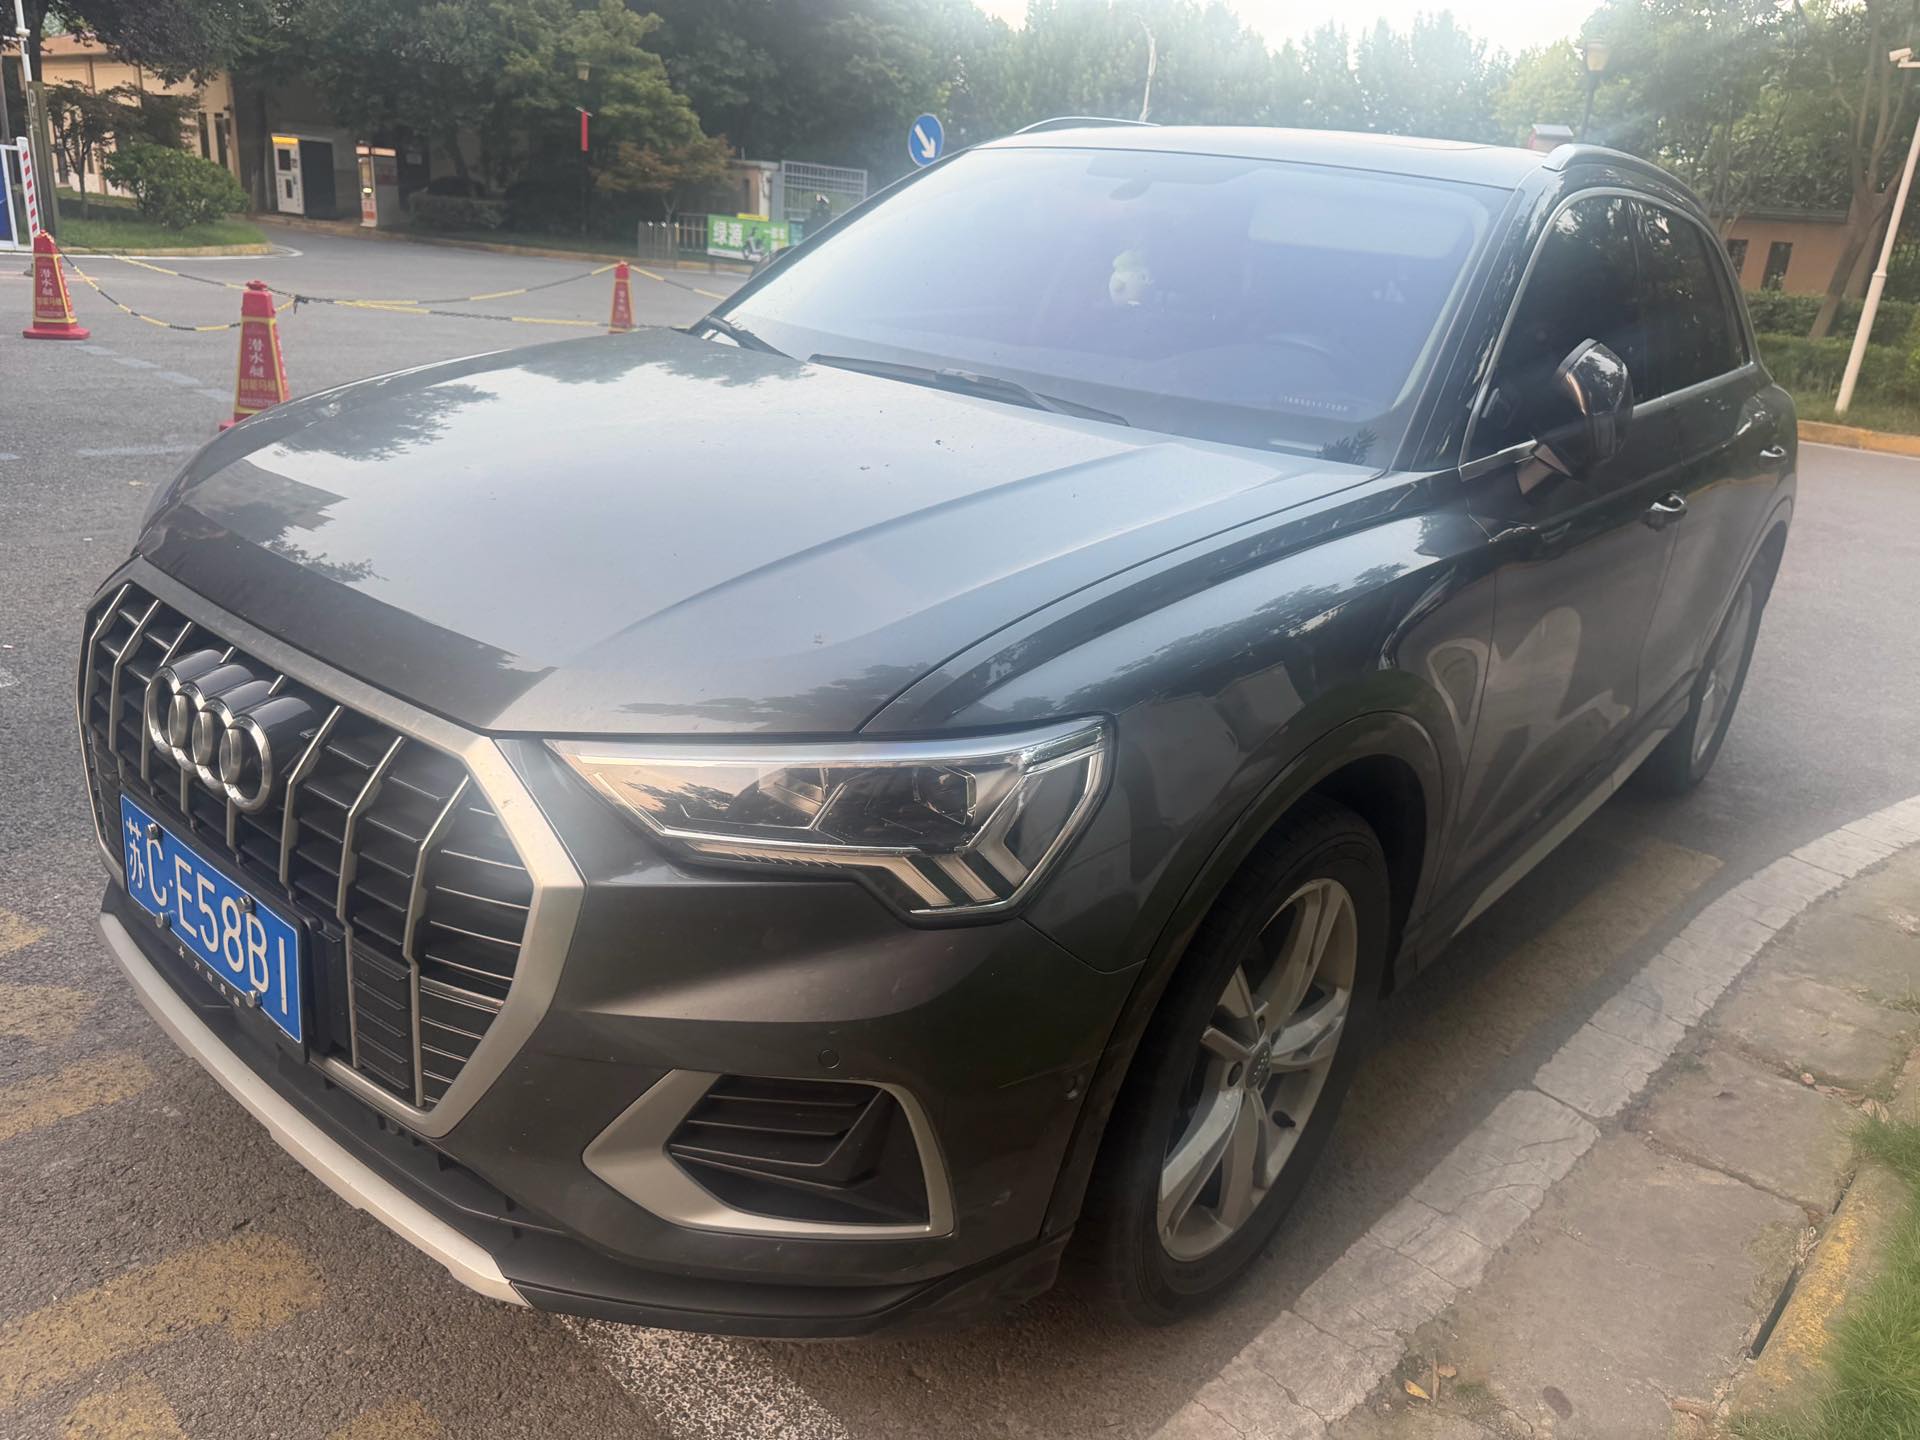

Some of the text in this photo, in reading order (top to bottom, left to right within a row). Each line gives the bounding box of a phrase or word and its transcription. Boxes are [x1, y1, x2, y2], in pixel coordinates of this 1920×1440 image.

[41, 268, 54, 297] 潜水艇
[248, 338, 264, 378] 潜水艇
